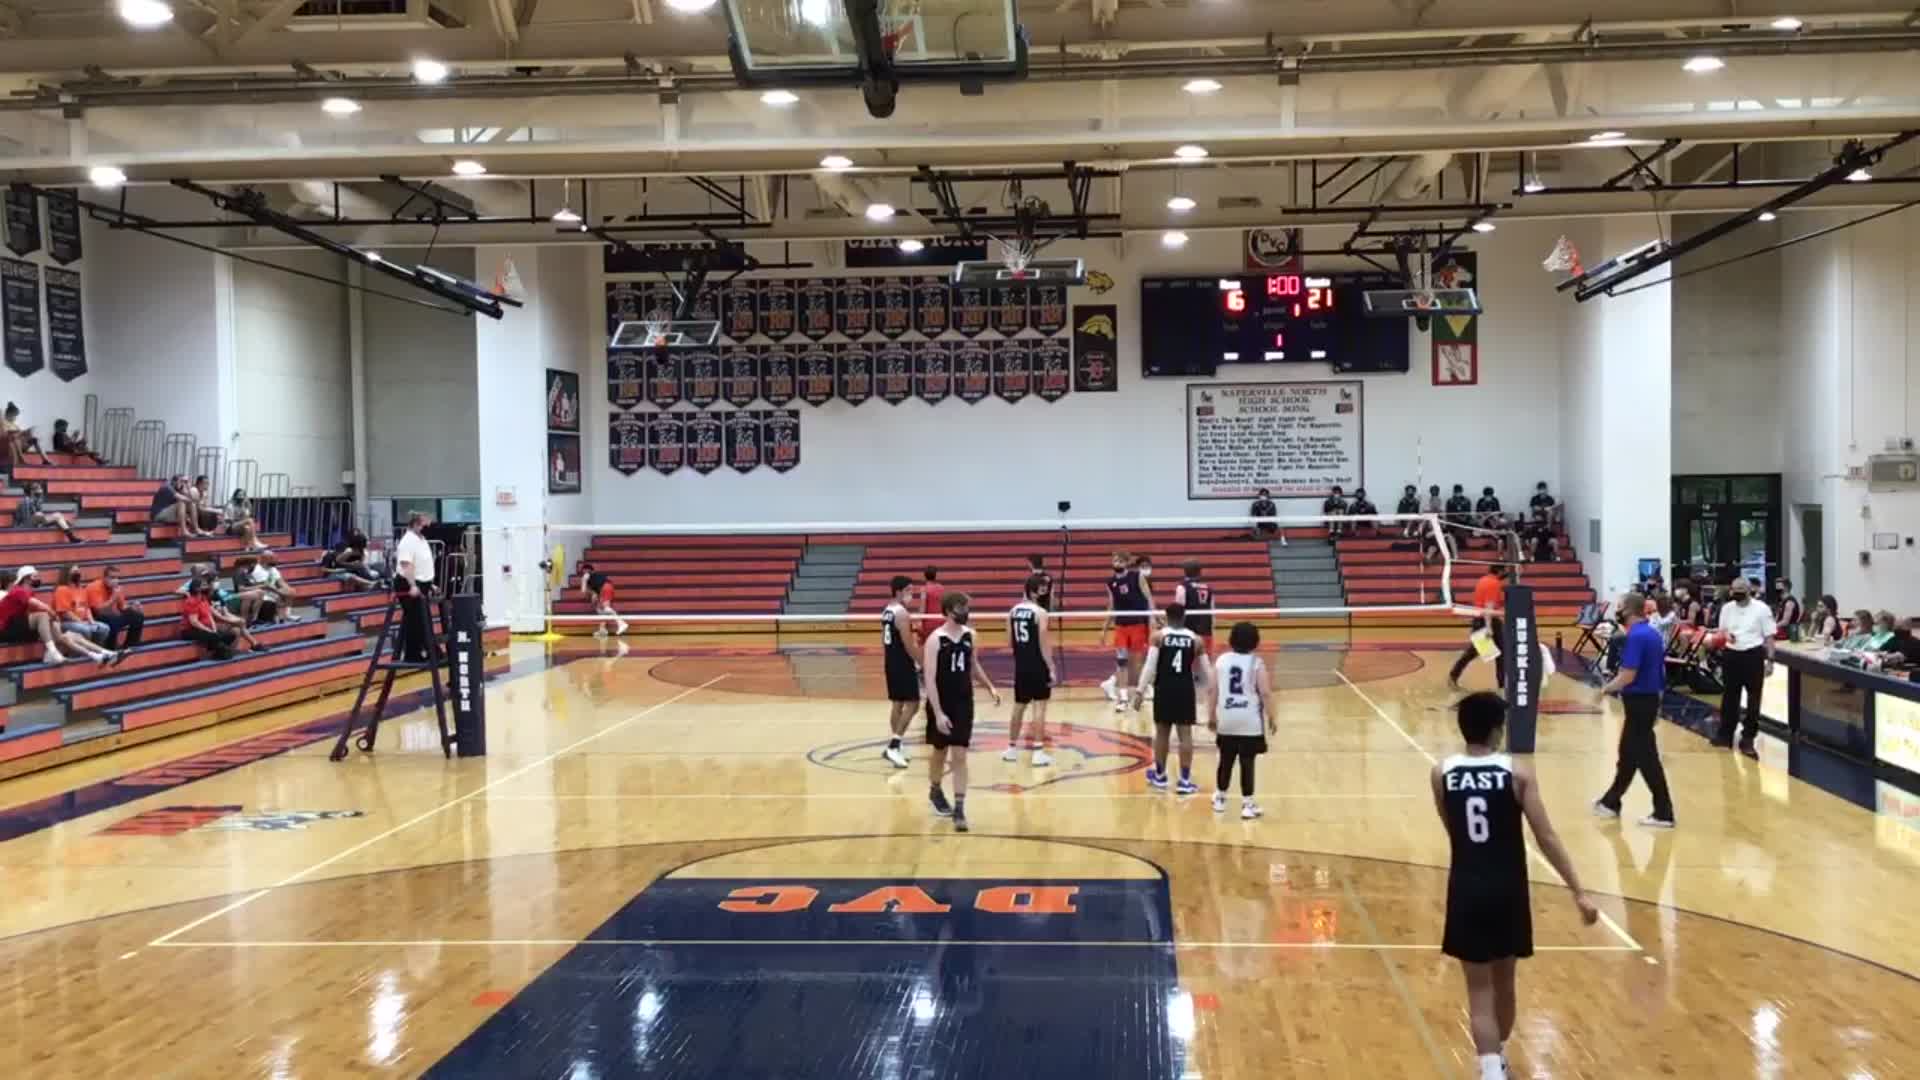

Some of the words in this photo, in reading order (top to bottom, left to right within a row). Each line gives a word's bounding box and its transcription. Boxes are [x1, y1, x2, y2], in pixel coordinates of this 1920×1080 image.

[1267, 276, 1300, 295] 1:00
[1227, 290, 1246, 311] 6
[1307, 288, 1333, 309] 21
[1164, 636, 1192, 647] EAST
[951, 651, 966, 672] 14
[1172, 650, 1183, 673] 4
[1516, 617, 1528, 707] HUSKIES
[1229, 666, 1244, 695] 2
[1446, 771, 1508, 791] EAST
[1466, 796, 1490, 843] 6
[717, 884, 1079, 914] DVC
